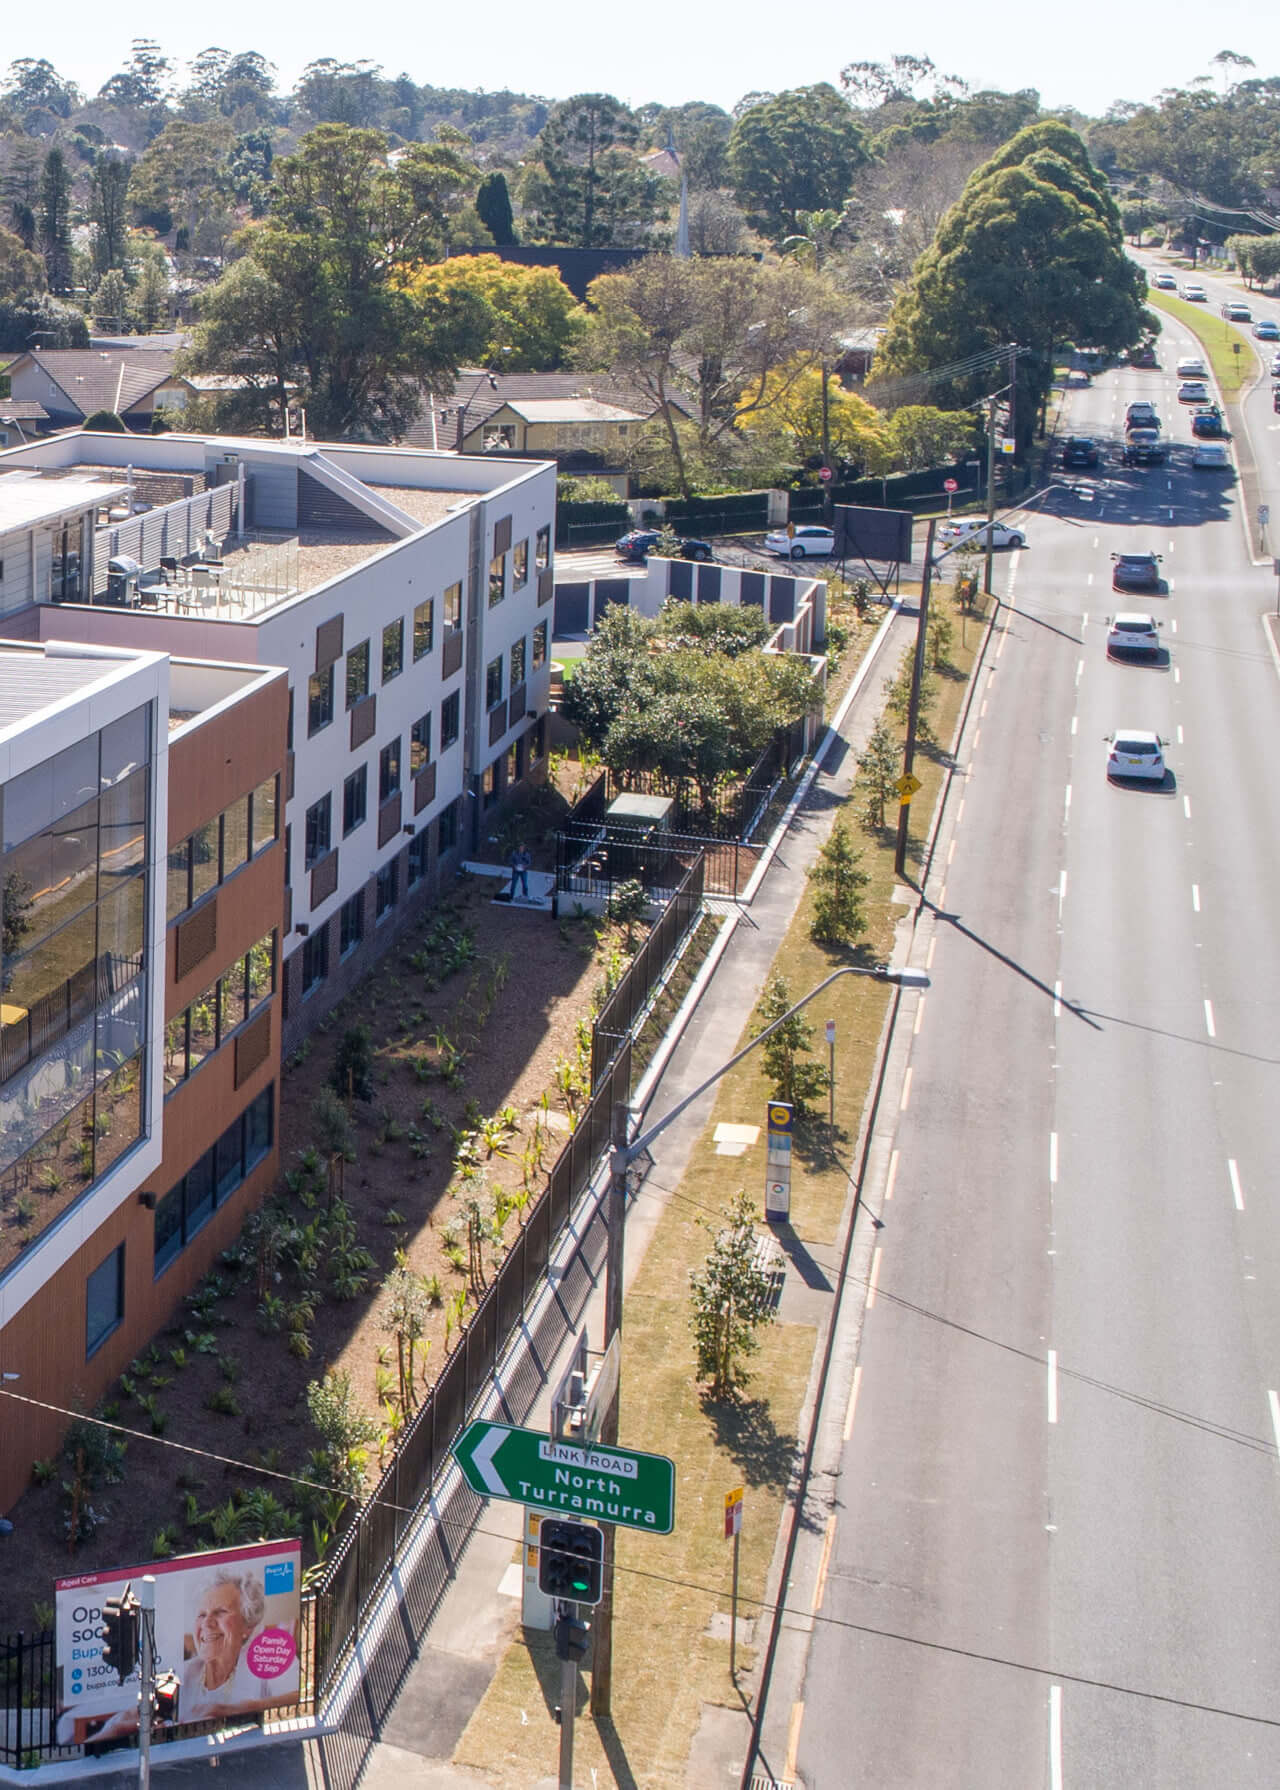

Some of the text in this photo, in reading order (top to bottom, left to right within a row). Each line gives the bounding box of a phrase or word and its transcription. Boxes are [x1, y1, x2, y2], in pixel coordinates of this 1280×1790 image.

[543, 1445, 634, 1473] LINK ROAD
[555, 1468, 621, 1496] North
[518, 1481, 656, 1524] Turramurra
[61, 1575, 97, 1587] Aged Care
[72, 1606, 101, 1624] Op
[262, 1636, 288, 1647] Family
[253, 1644, 291, 1656] Open Day
[253, 1654, 288, 1665] Saturday
